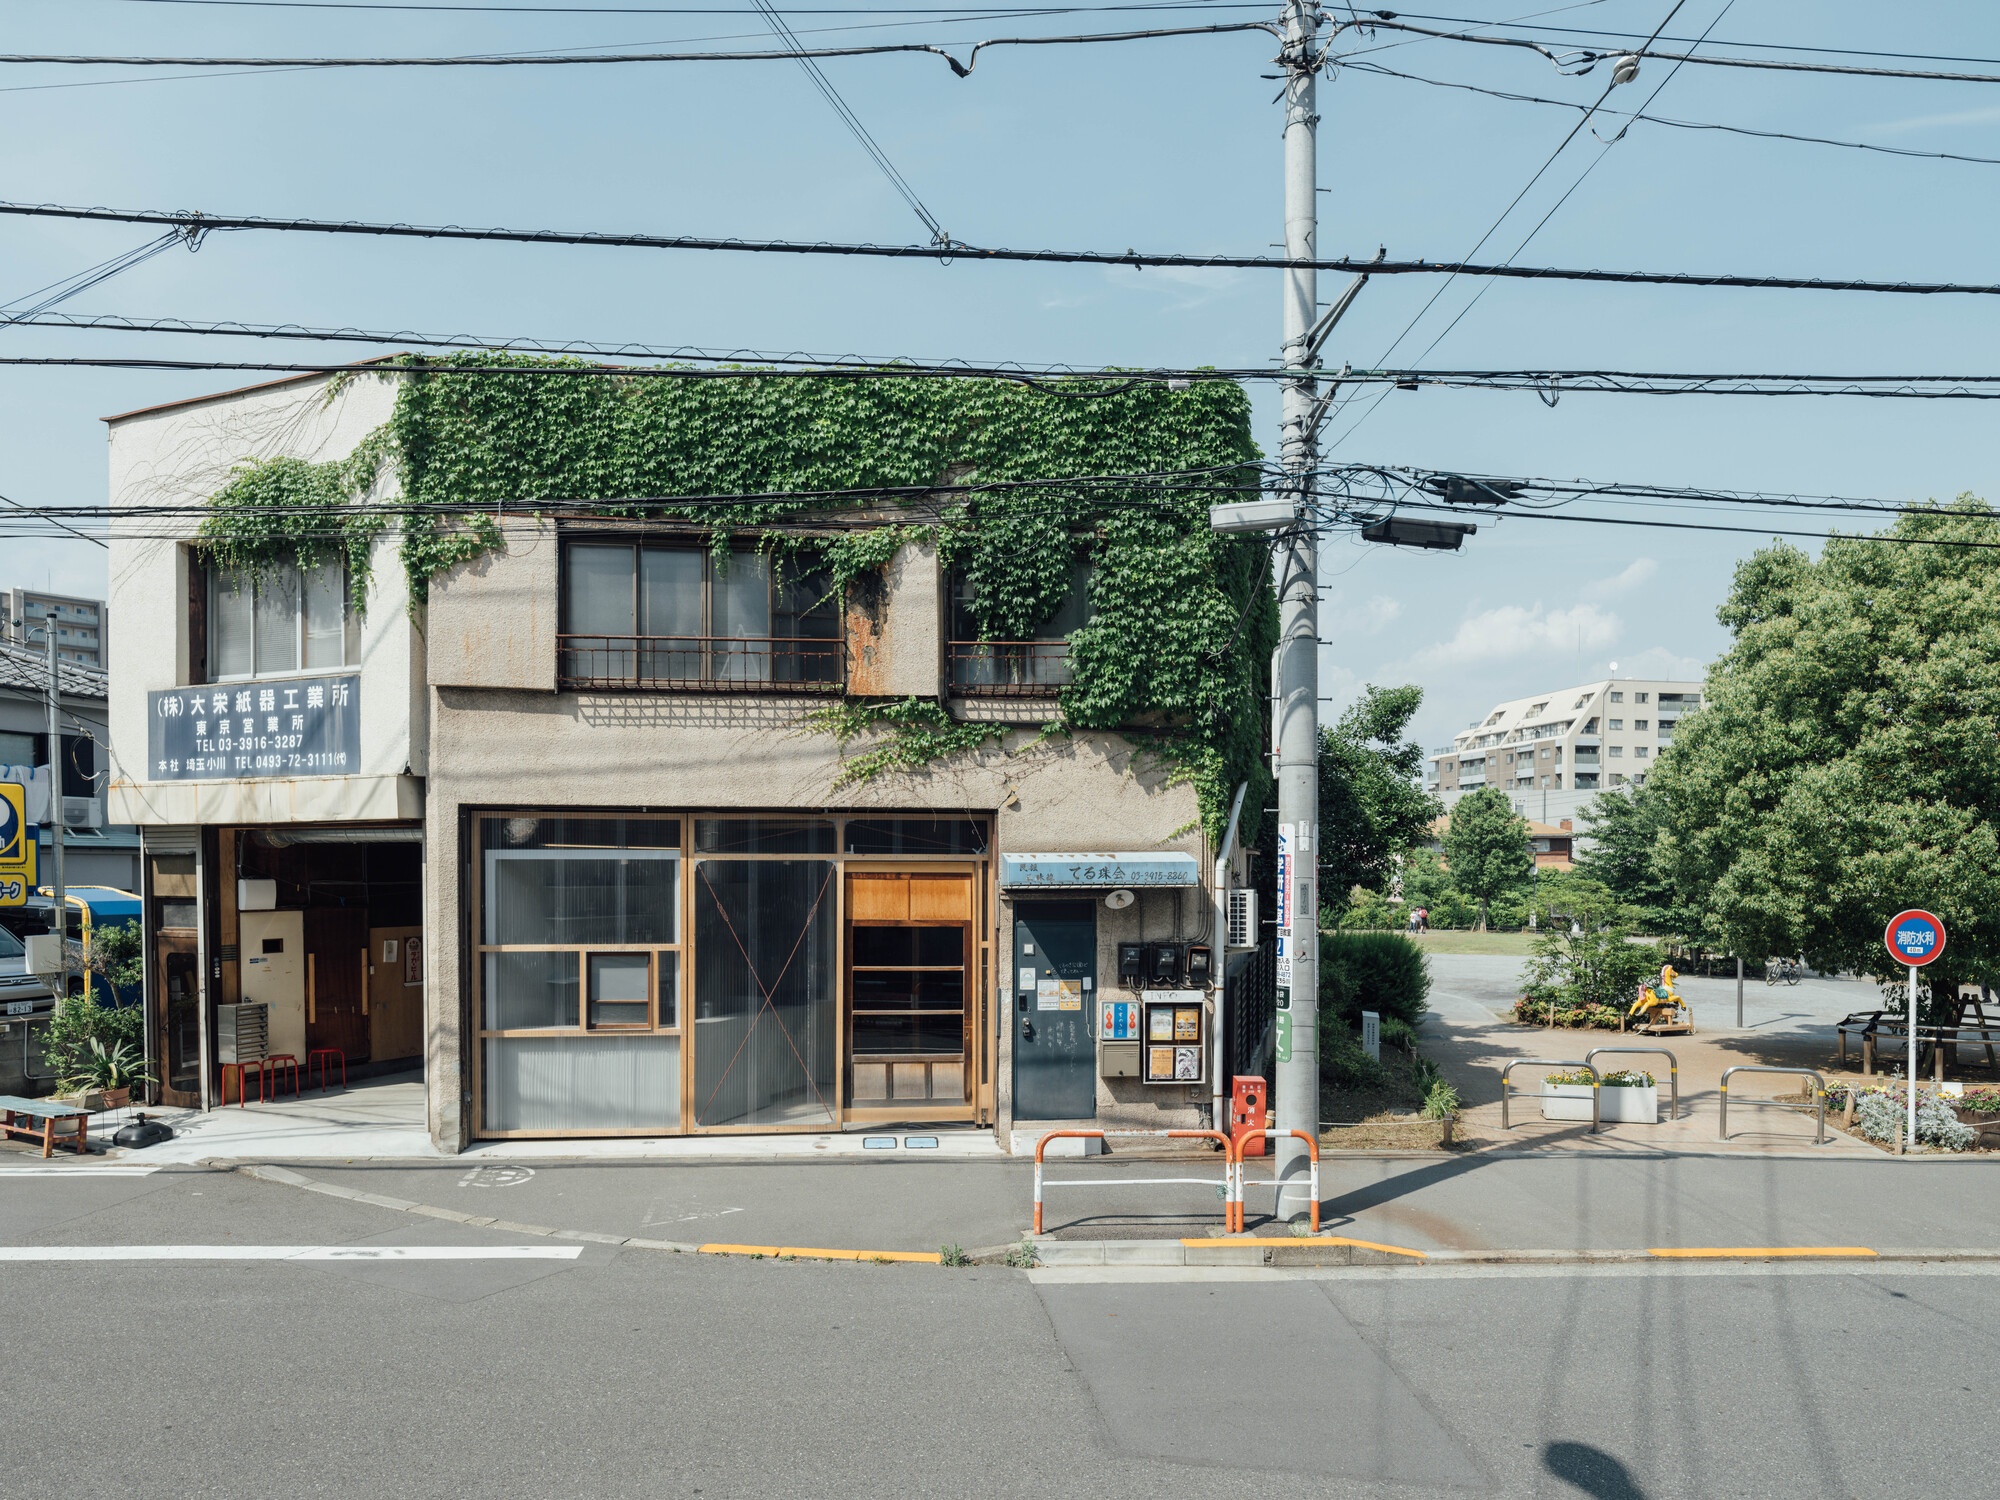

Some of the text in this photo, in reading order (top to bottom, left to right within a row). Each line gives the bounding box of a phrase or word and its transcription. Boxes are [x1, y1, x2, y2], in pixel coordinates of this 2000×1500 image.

[196, 715, 304, 736] 東京営業所
[196, 734, 304, 753] TEL 03-3916-3287
[158, 758, 179, 773] 本社
[185, 756, 226, 772] 埼玉小川
[235, 756, 253, 770] TEL
[1897, 930, 1935, 946] 消防水利
